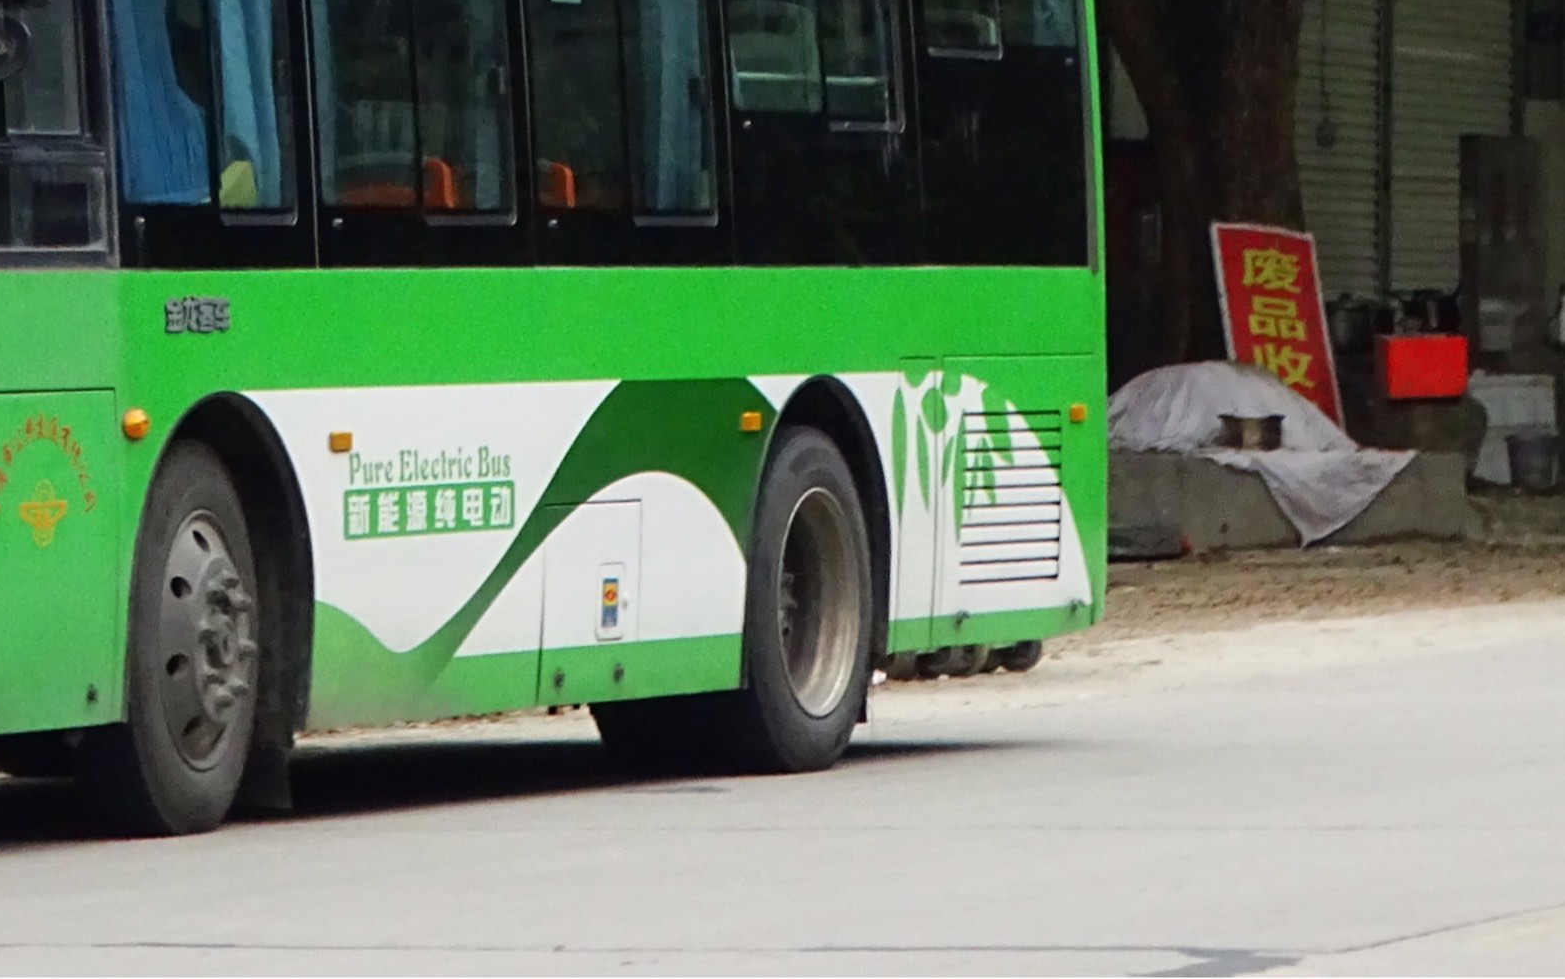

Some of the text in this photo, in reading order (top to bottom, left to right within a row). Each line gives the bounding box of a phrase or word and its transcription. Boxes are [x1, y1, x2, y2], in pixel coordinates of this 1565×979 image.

[348, 445, 512, 485] Pure Electric Bus
